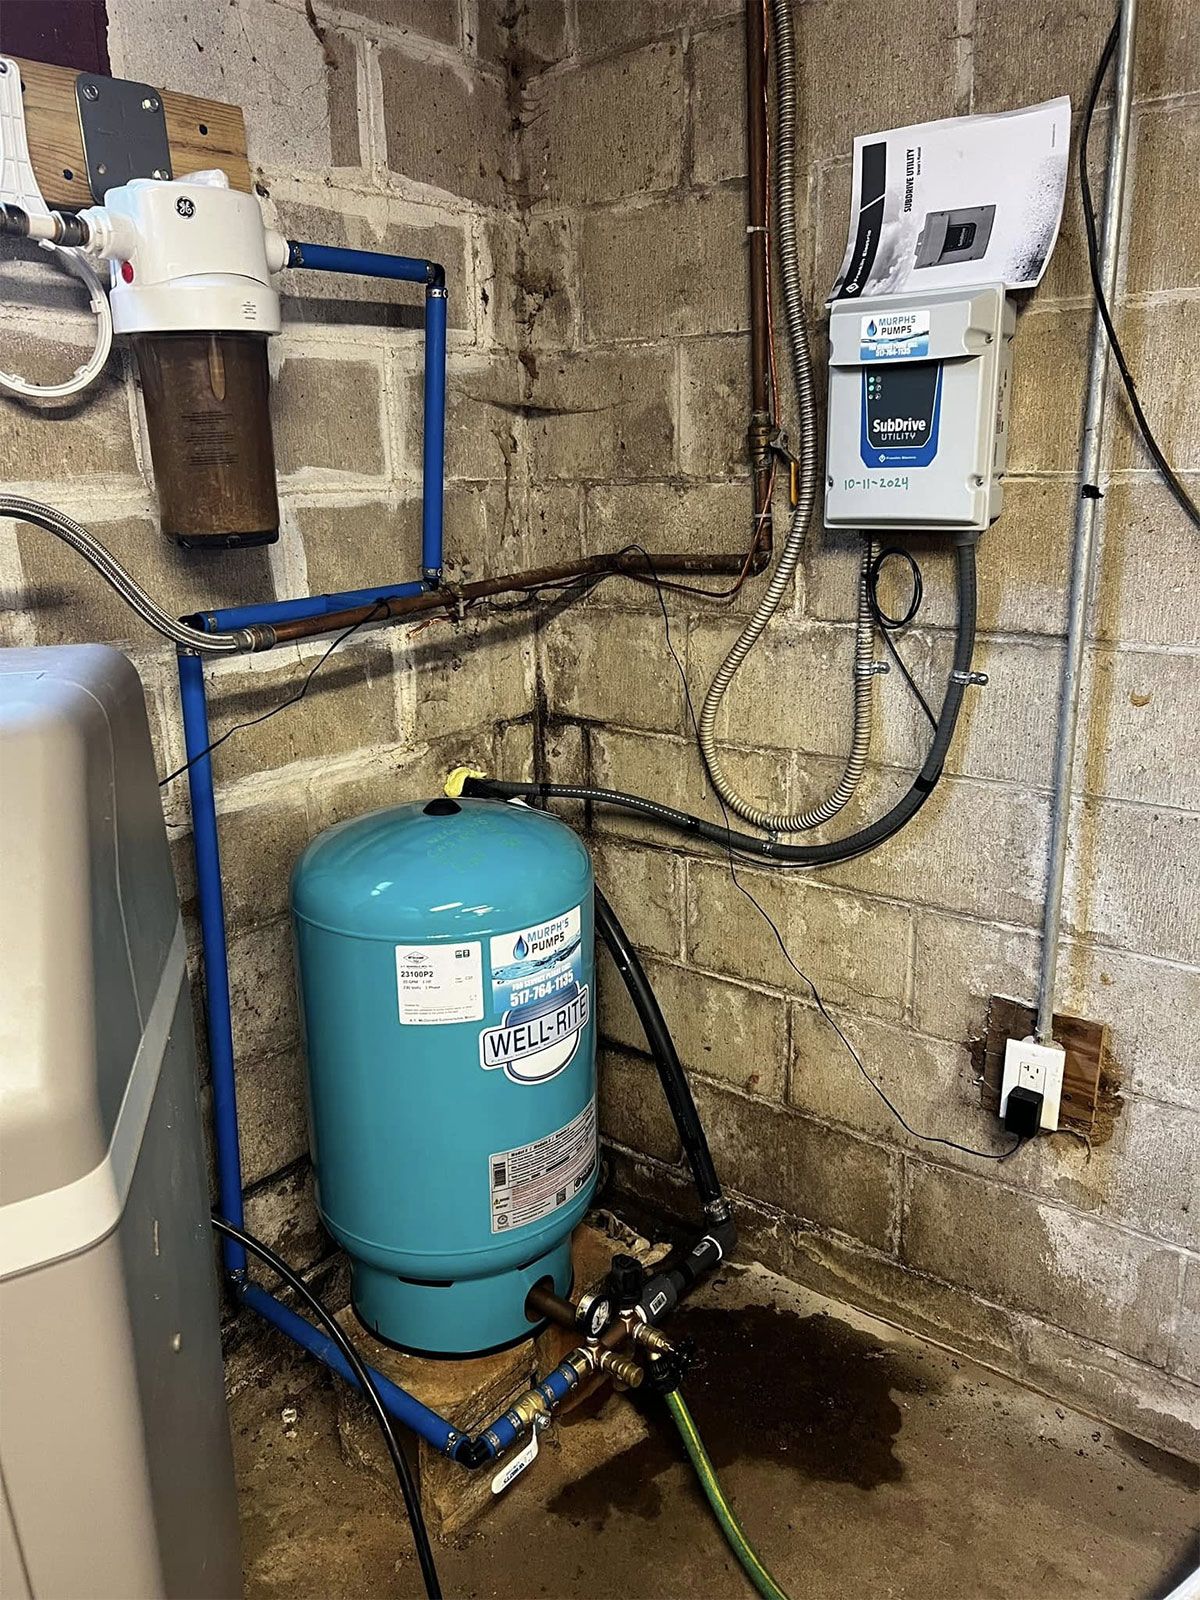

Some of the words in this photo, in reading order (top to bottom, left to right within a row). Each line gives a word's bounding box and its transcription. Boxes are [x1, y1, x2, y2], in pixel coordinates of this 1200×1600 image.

[906, 149, 914, 176] UTILITY
[903, 177, 914, 213] SUBDRIVE
[878, 315, 916, 326] MURPHS
[881, 325, 912, 335] PUMPS
[872, 417, 926, 433] SubDrive
[881, 432, 916, 441] UTILITY
[844, 476, 909, 491] 10-11-2024
[527, 917, 569, 942] MURPH'S
[531, 931, 565, 954] PUMPS
[400, 970, 434, 978] 23100P2
[510, 968, 575, 1008] 517-764-1135
